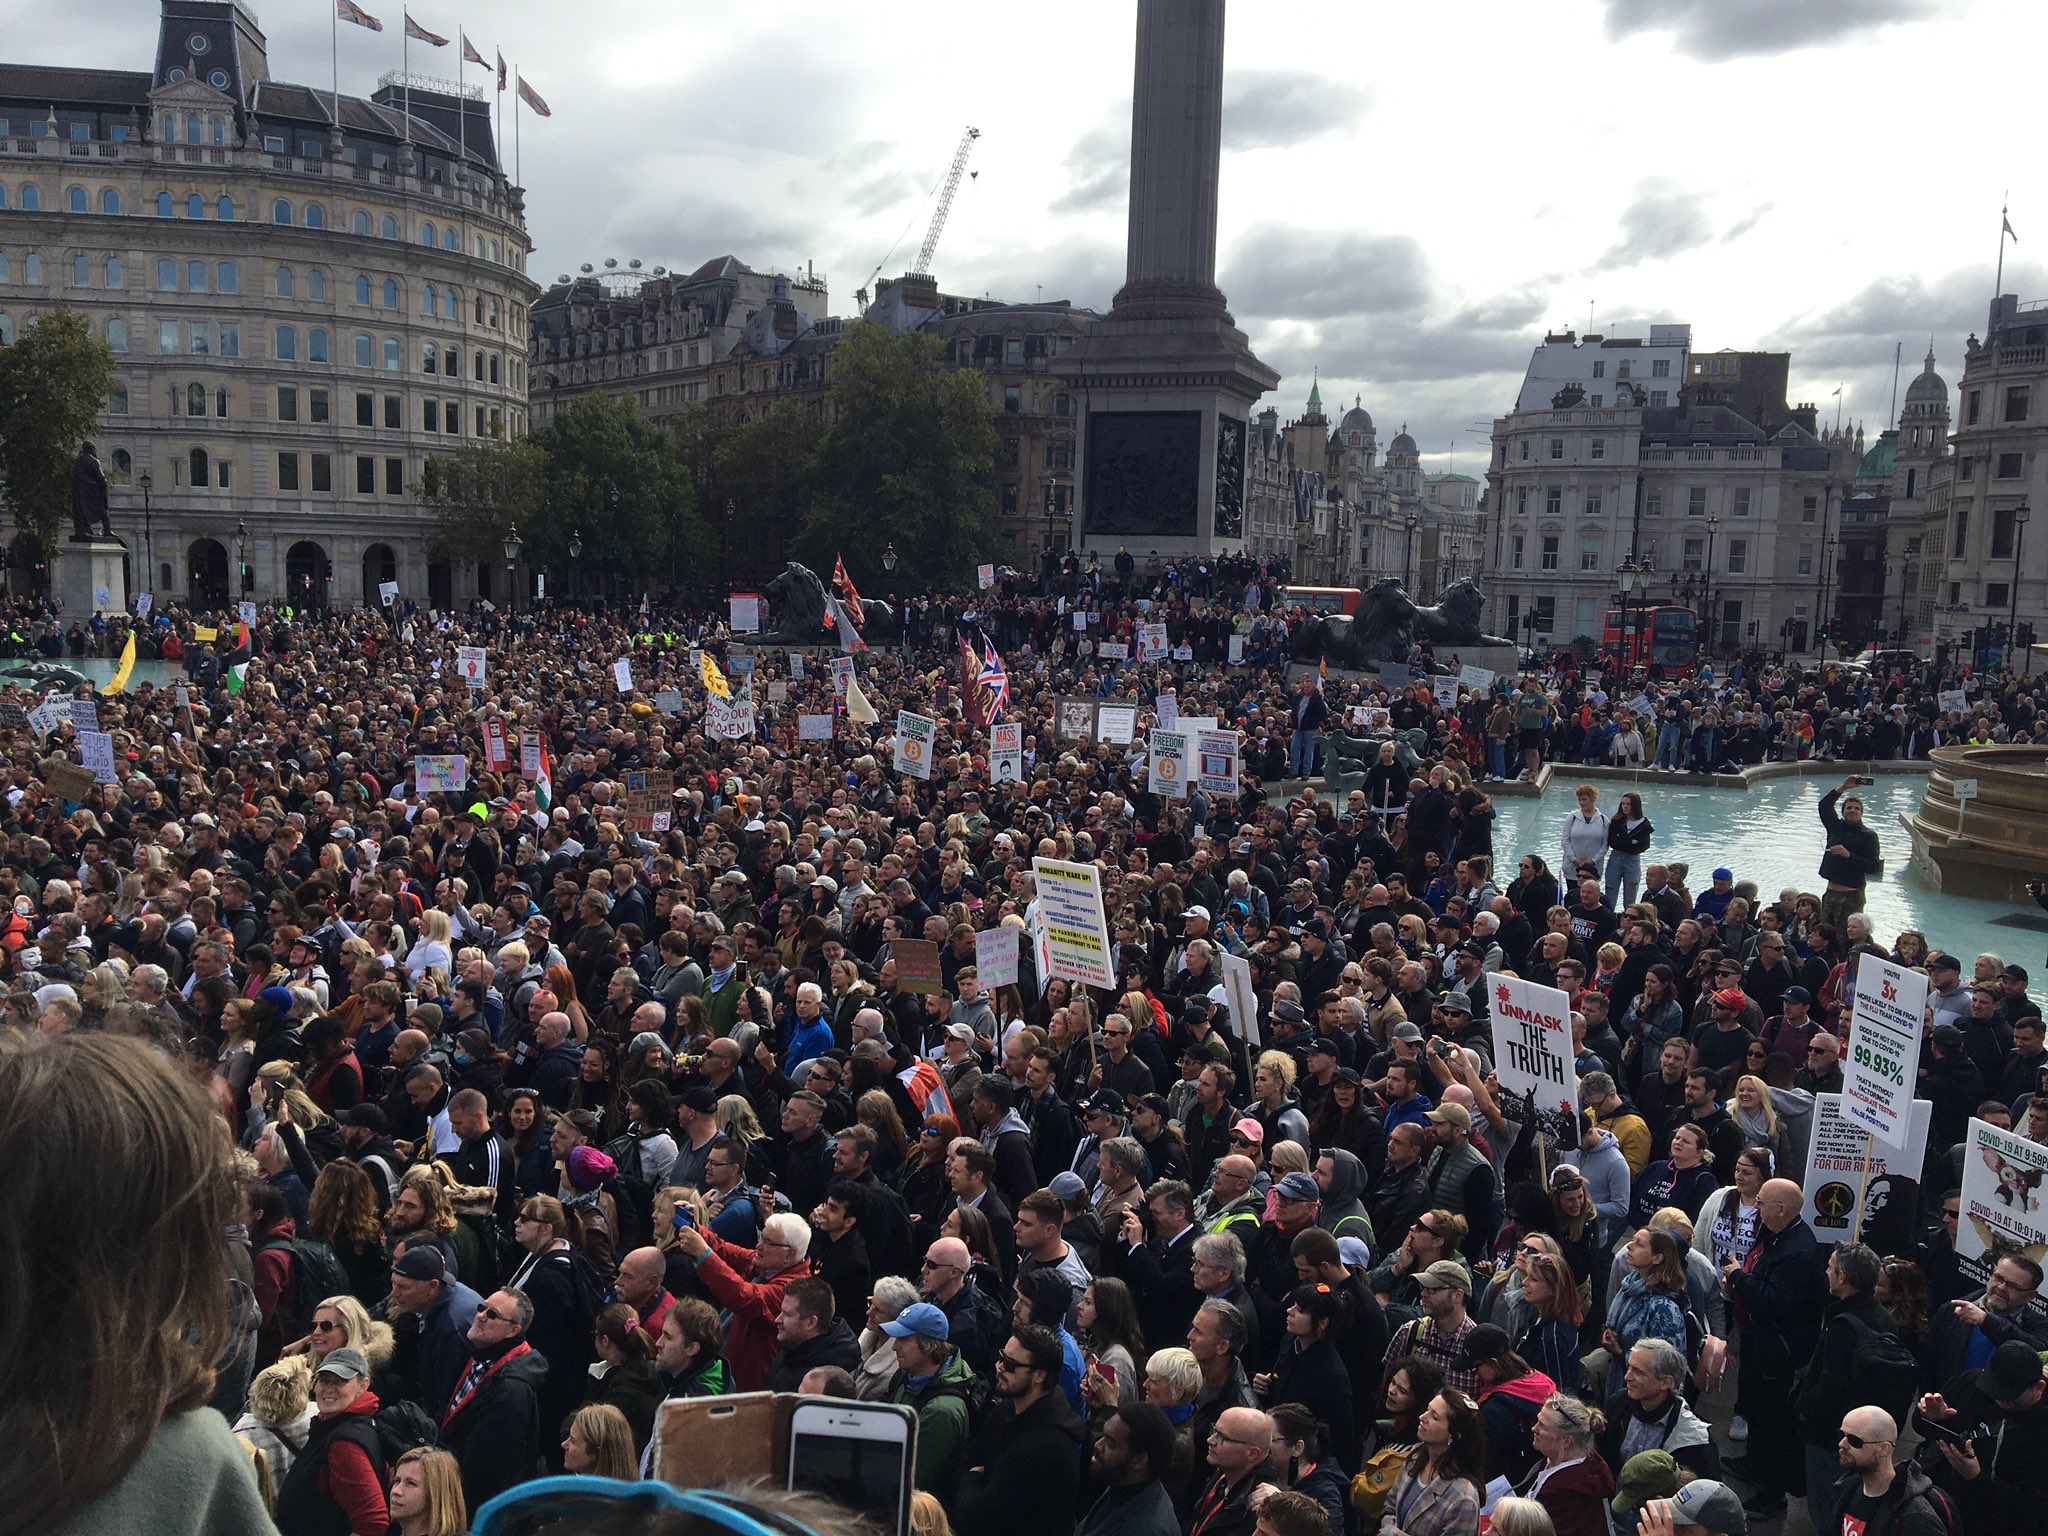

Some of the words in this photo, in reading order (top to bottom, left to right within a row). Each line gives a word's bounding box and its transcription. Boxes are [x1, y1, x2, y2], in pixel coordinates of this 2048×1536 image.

[731, 708, 749, 719] OUR
[901, 717, 930, 734] FREEDOM
[84, 735, 108, 745] STUFF
[901, 731, 927, 743] BITCOIN
[996, 730, 1016, 742] MASS
[1154, 736, 1184, 748] FREEDOM
[88, 746, 104, 757] THE
[1155, 750, 1182, 759] BITCOIN
[84, 759, 109, 767] STUPID
[1038, 867, 1065, 877] HUMANITY
[1066, 871, 1081, 880] WAKE
[1043, 894, 1066, 903] POLITICIANS
[1072, 890, 1094, 898] TERRORISM
[1050, 917, 1076, 926] PROPAGANDA
[1058, 929, 1081, 938] PANDEMIC
[1571, 924, 1595, 936] ARMY
[1001, 953, 1016, 962] AWAY
[1053, 958, 1075, 967] TOGETHER
[1883, 968, 1900, 980] YOU'RE
[1857, 992, 1871, 1002] MORE
[1872, 997, 1887, 1009] LIKELY
[1888, 1004, 1894, 1012] TO
[1903, 1010, 1917, 1022] FROM
[1498, 1002, 1564, 1032] UNMASK
[1860, 1002, 1868, 1010] THE
[1869, 1005, 1878, 1014] FLU
[1879, 1009, 1892, 1020] THAN
[1892, 1015, 1913, 1030] COVID-19
[1520, 1022, 1548, 1051] THE
[1859, 1025, 1872, 1035] ODDS
[1880, 1036, 1890, 1044] NOT
[1890, 1039, 1906, 1051] DYING
[1862, 1035, 1872, 1044] DUE
[1507, 1040, 1564, 1085] TRUTH
[1854, 1045, 1904, 1086] 99.93%
[1856, 1074, 1872, 1087] THAT'S
[1872, 1082, 1894, 1098] WITHOUT
[1858, 1085, 1885, 1102] FACTORING
[1848, 1088, 1878, 1108] INACCURATE
[1878, 1104, 1898, 1119] TESTING
[1866, 1106, 1876, 1116] AND
[1851, 1107, 1865, 1120] FALSE
[1865, 1114, 1890, 1132] POSITIVES!
[1979, 1130, 2013, 1156] COVID-19
[2014, 1146, 2023, 1157] AT
[1813, 1159, 1832, 1169] FOR
[1833, 1161, 1851, 1171] OUR
[1970, 1200, 2002, 1224] COVID-19
[2003, 1215, 2012, 1227] AT
[2014, 1220, 2033, 1238] 10:01
[2034, 1230, 2046, 1243] PM
[1960, 1259, 1986, 1276] THERE'S
